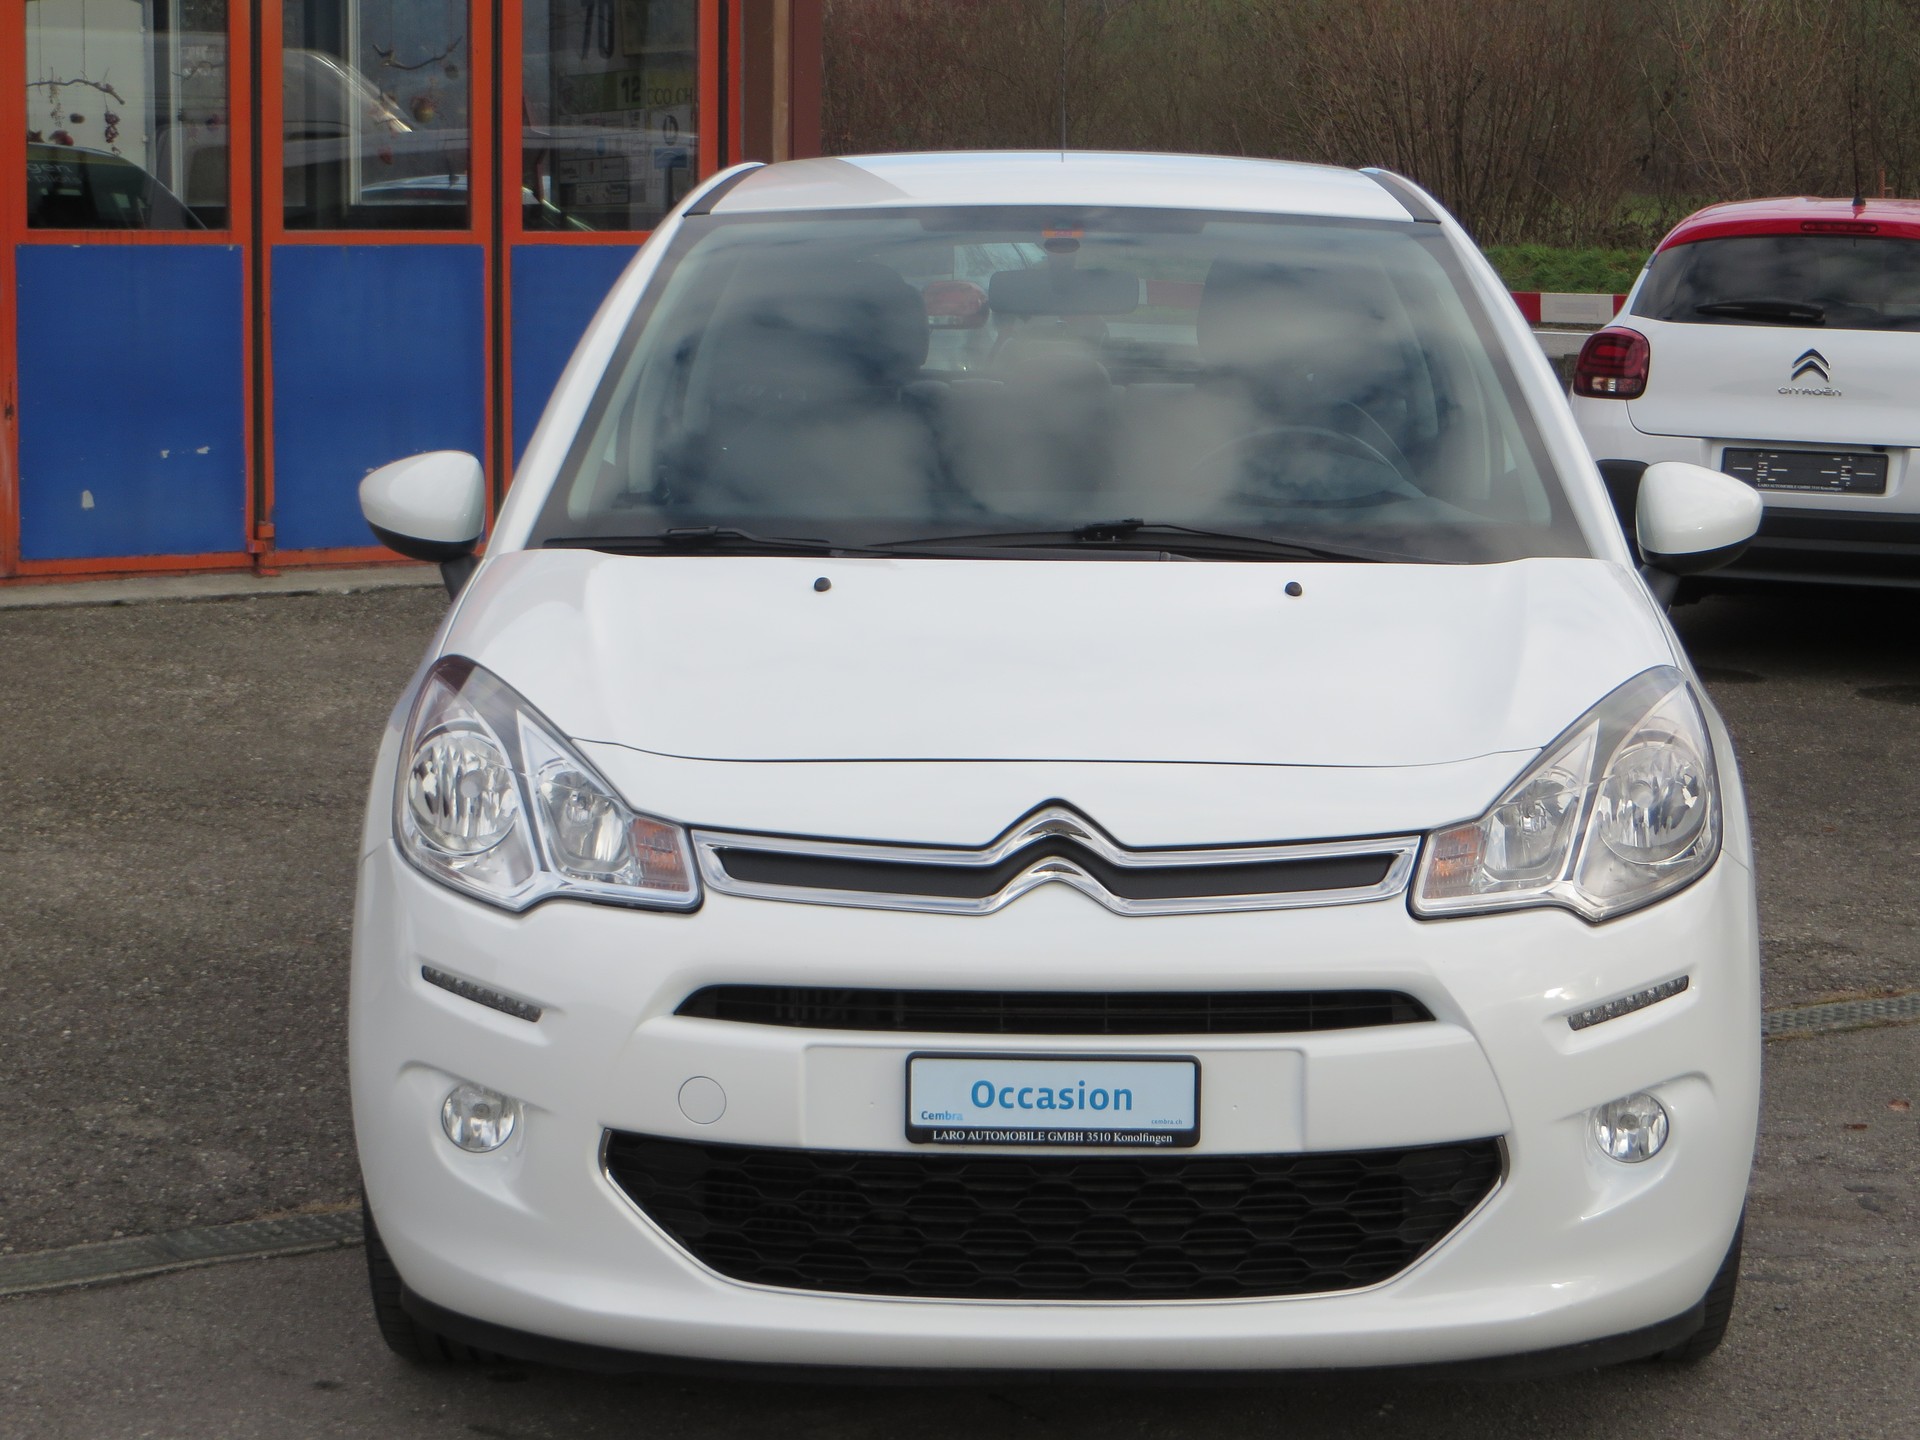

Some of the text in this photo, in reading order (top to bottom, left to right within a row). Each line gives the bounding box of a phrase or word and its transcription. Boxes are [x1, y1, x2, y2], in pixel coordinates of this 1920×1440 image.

[971, 1080, 1133, 1111] Occasion
[921, 1110, 963, 1121] Cembra
[1151, 1118, 1183, 1126] cembra.ch
[933, 1130, 1173, 1145] LARO AUTOMOBILE GMBH 3510 Konolfingen
